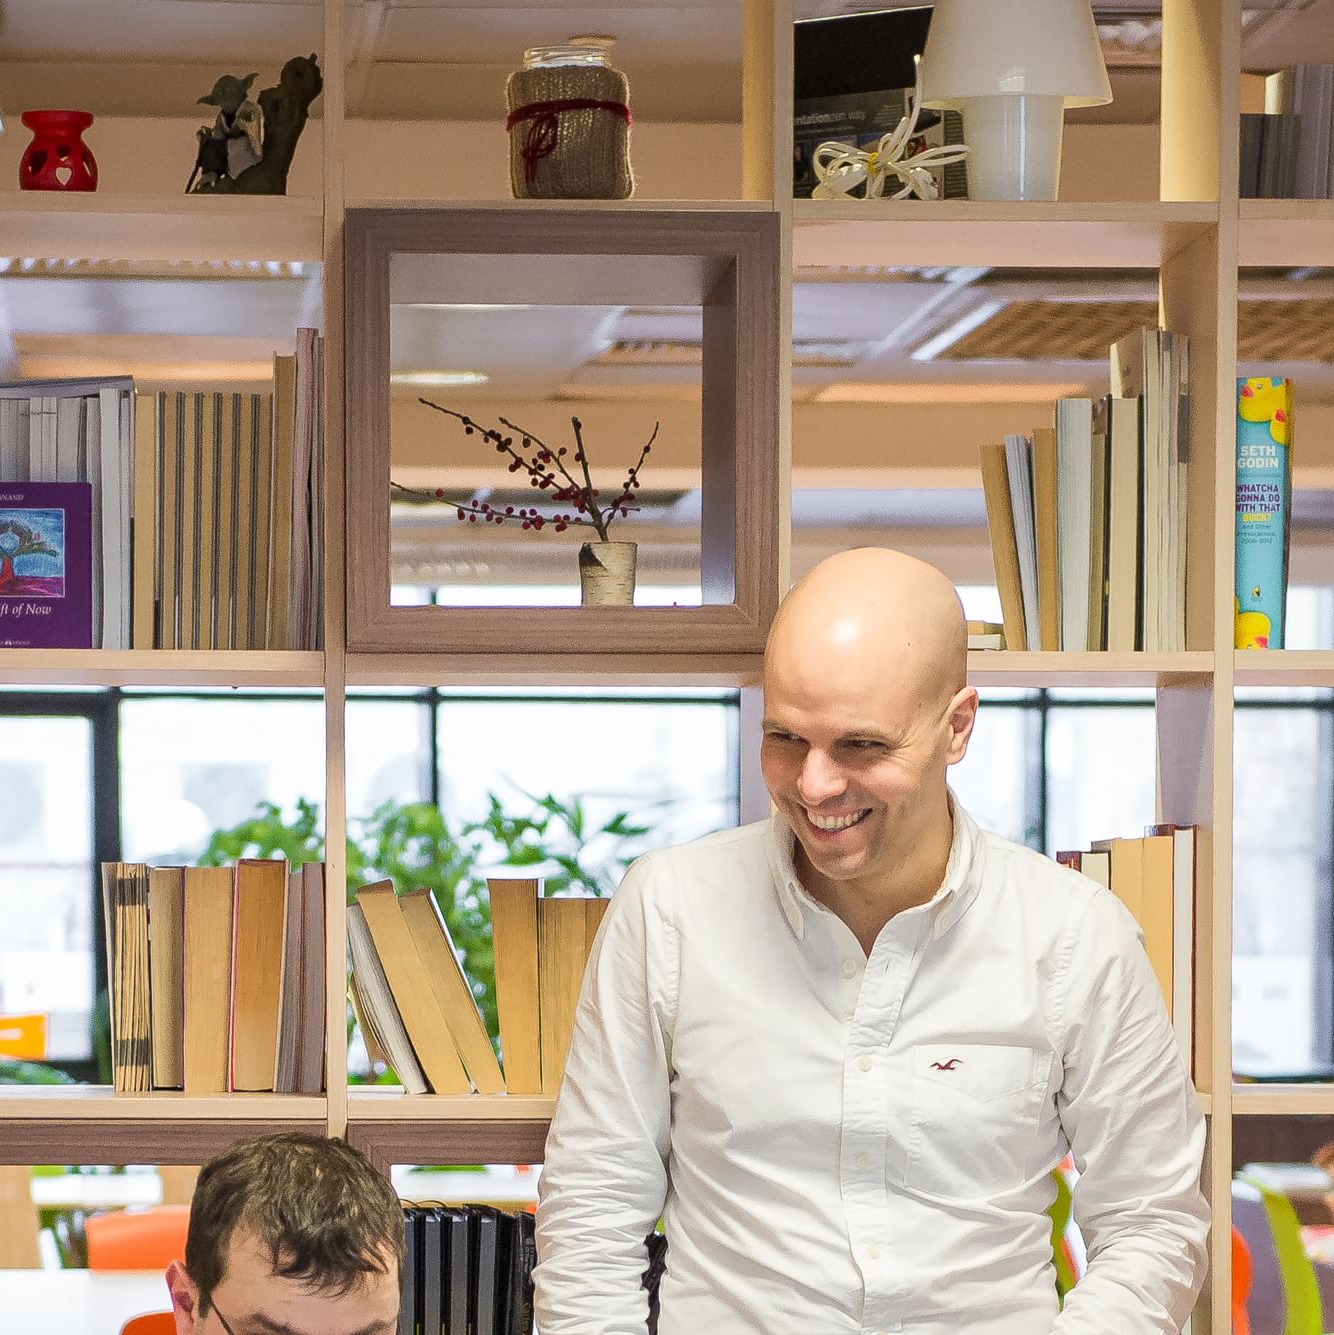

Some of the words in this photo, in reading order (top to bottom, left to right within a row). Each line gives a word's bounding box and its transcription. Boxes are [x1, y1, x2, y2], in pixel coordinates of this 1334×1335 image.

[1240, 445, 1276, 457] SETH
[1237, 457, 1279, 469] GODIN
[1237, 483, 1279, 493] WHATCHA
[1236, 494, 1266, 503] GONNA
[1268, 494, 1280, 502] DO
[1235, 503, 1256, 512] WITH
[1259, 503, 1281, 512] THAT
[12, 602, 25, 618] of
[26, 603, 52, 615] Now
